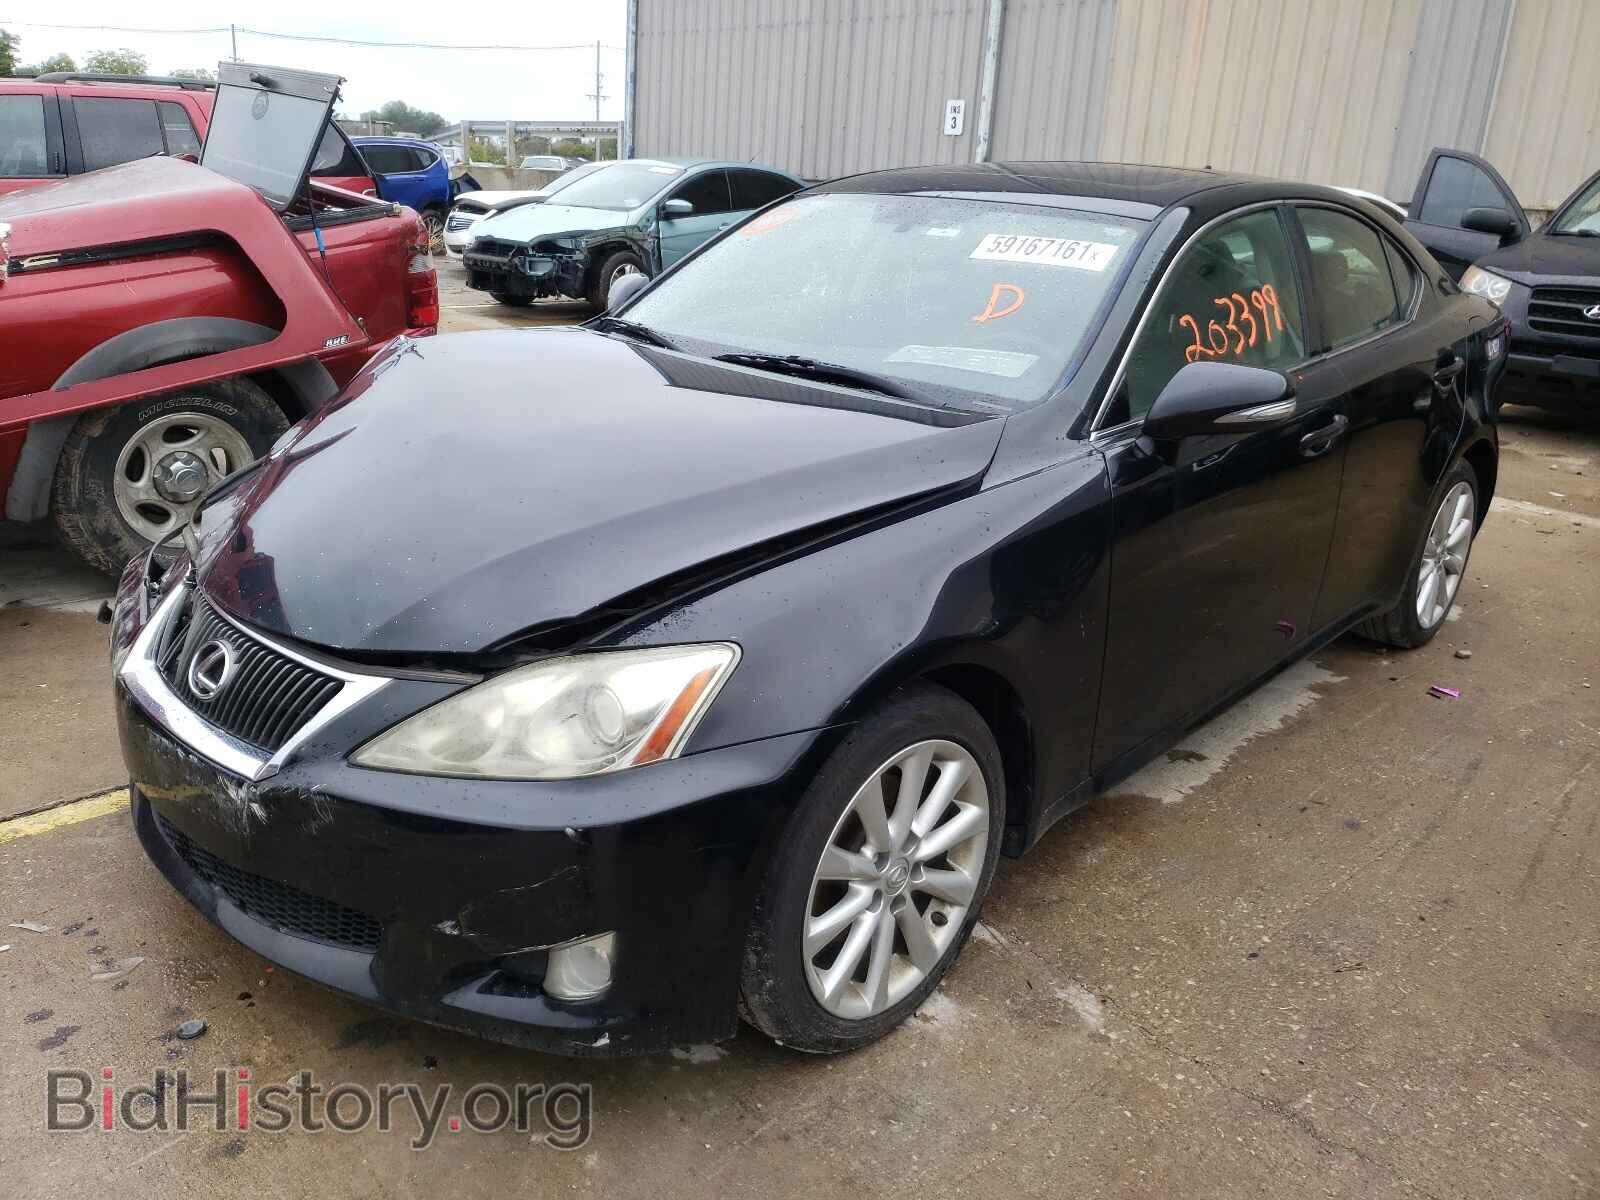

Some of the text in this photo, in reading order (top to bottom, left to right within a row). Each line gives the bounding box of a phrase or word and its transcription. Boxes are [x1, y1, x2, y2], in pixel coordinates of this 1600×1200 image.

[950, 116, 957, 129] 3
[987, 235, 1093, 261] 59167161
[974, 282, 1025, 322] D
[138, 397, 238, 420] MICHELIN
